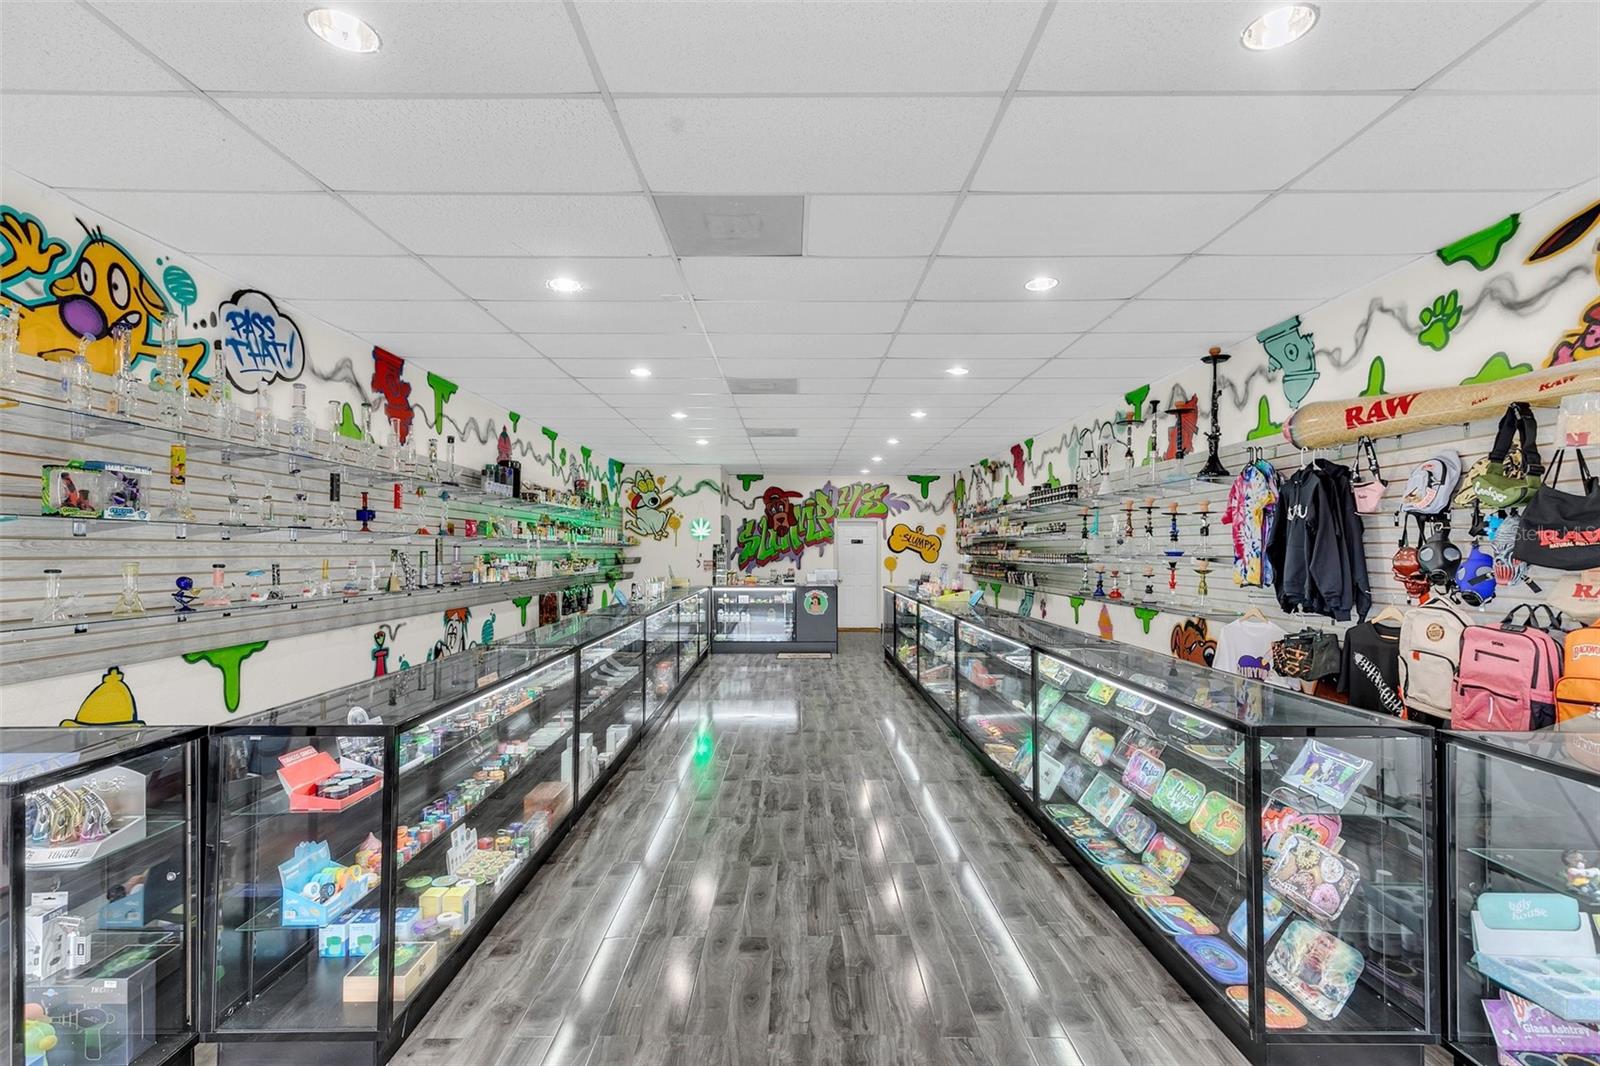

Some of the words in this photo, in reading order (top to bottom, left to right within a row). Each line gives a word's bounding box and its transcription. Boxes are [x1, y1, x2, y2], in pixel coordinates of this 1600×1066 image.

[225, 309, 275, 340] PASS
[225, 336, 295, 374] THAT!
[1345, 392, 1422, 430] RAW
[902, 533, 936, 552] SLUMPY
[1523, 1022, 1550, 1034] Glass
[1552, 1024, 1590, 1037] Ashtray
